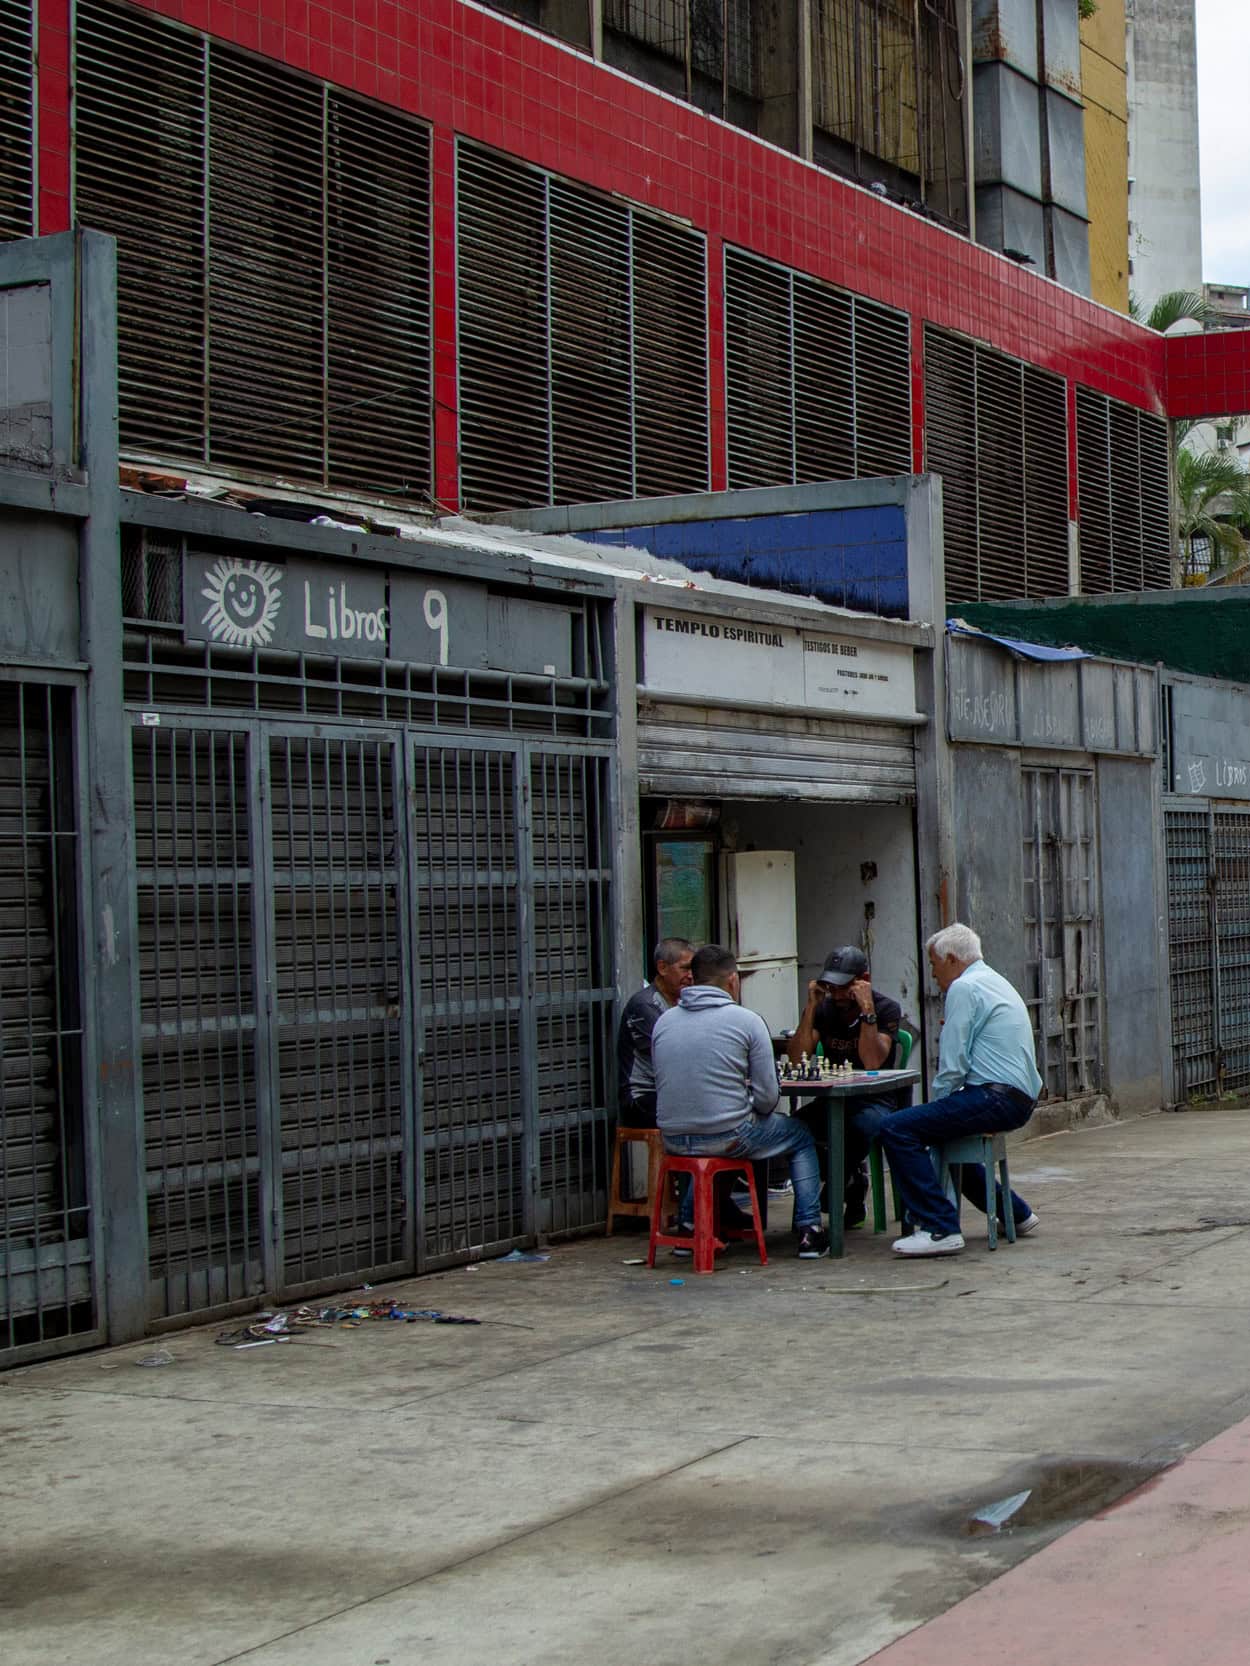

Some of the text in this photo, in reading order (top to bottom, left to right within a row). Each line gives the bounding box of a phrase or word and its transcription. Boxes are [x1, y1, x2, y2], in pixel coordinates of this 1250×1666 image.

[304, 579, 449, 666] Libros 9
[653, 616, 785, 648] TEMPLO ESPIRITUAL
[803, 640, 858, 657] TESTIGOS DE BEBER
